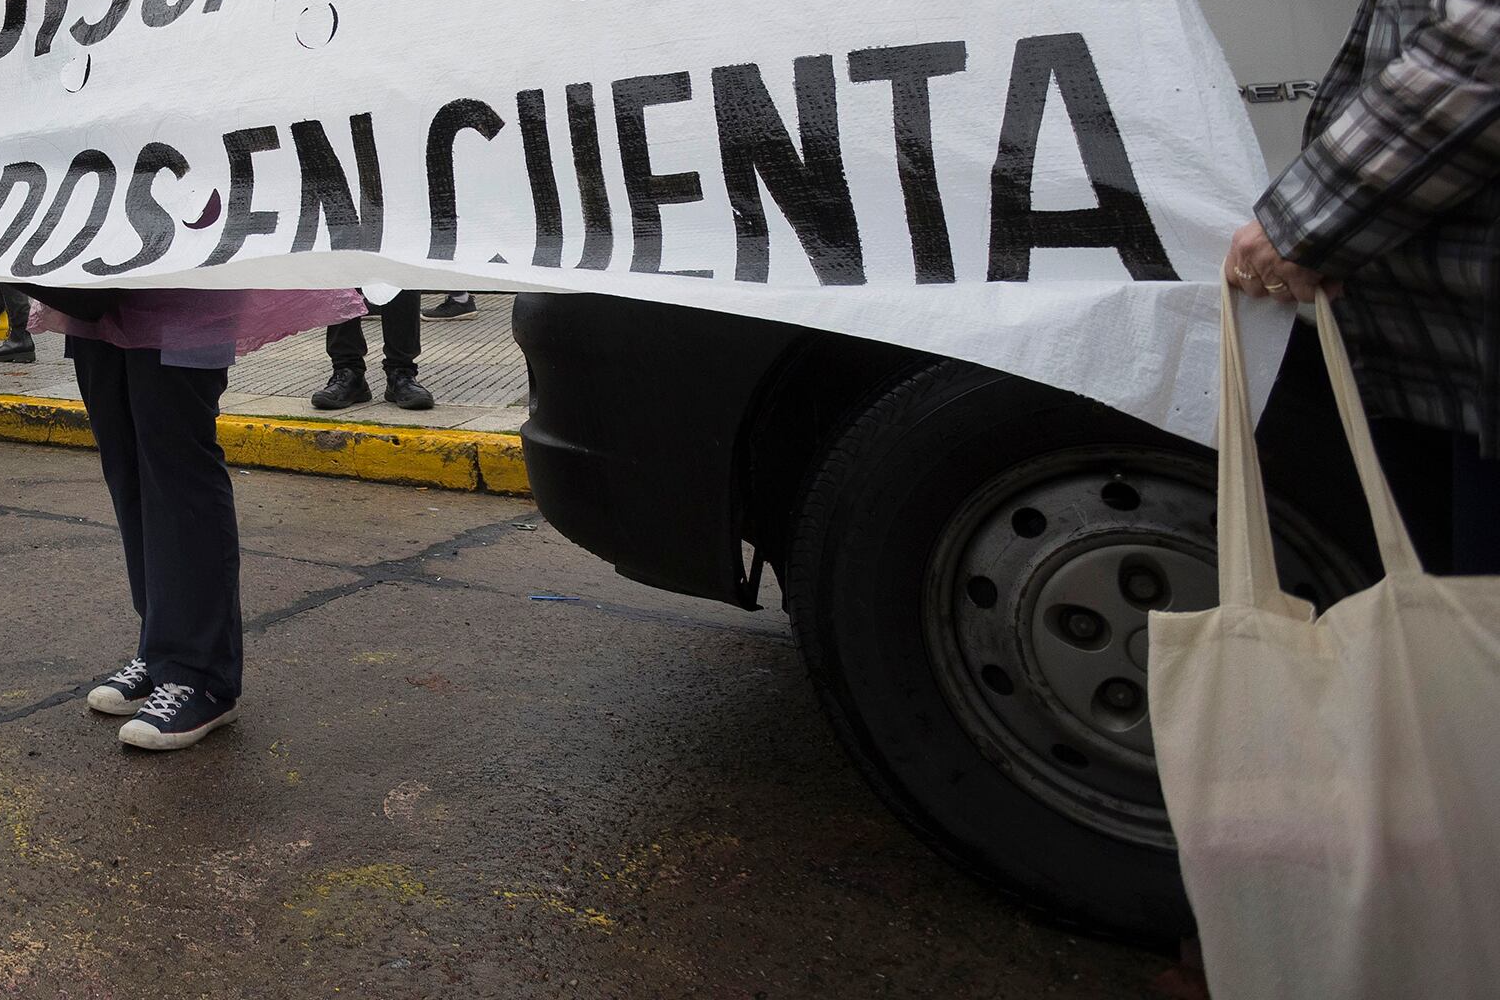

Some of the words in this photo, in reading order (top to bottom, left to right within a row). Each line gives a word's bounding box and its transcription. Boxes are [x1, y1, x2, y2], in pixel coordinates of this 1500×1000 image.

[198, 112, 384, 268] EN
[425, 32, 1182, 286] CUENTA
[1238, 80, 1319, 103] ER
